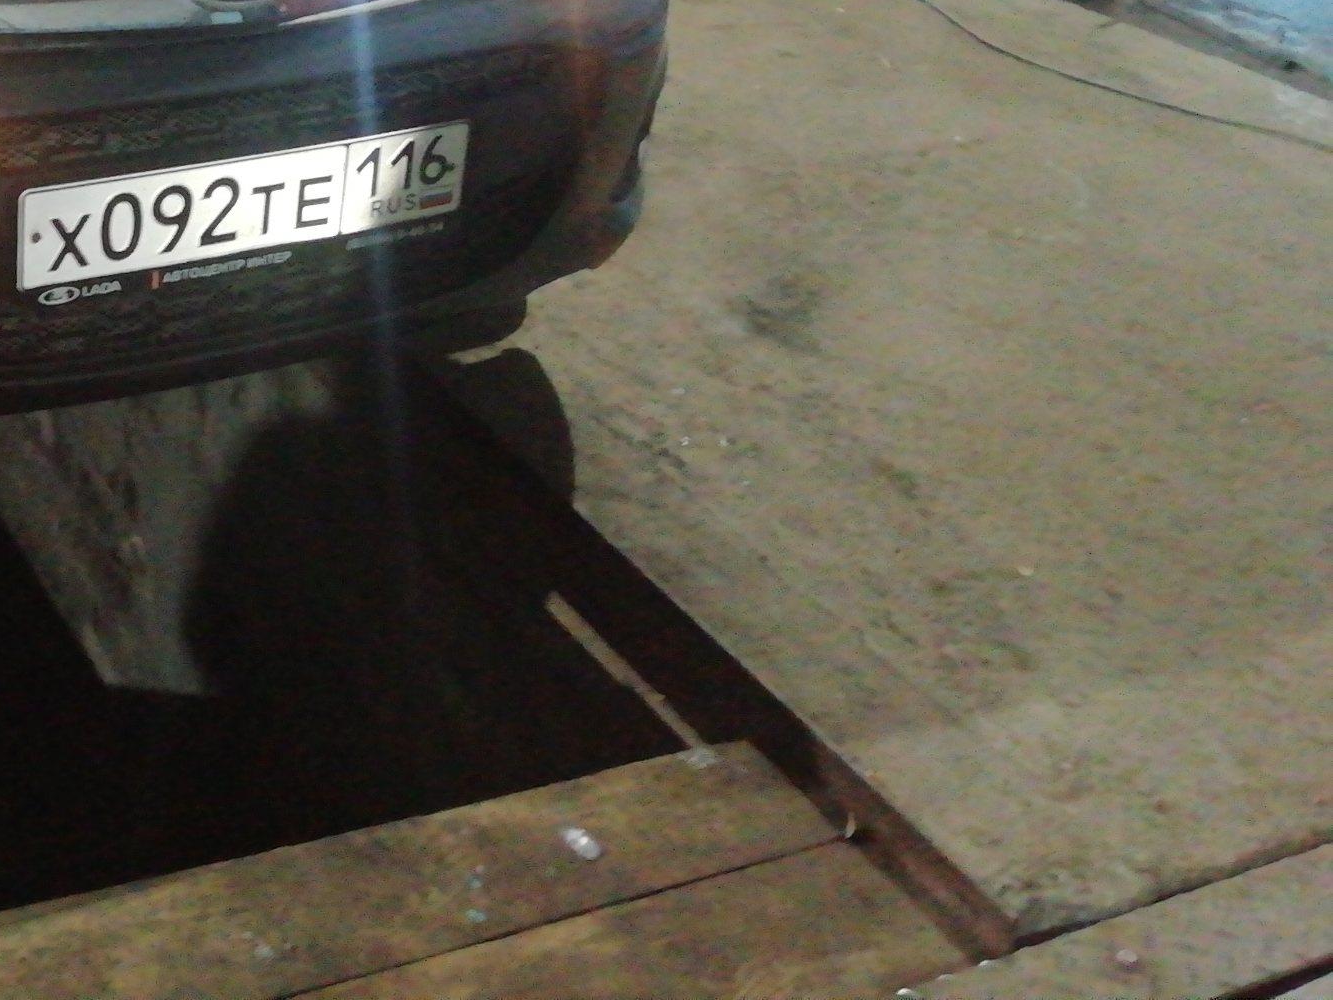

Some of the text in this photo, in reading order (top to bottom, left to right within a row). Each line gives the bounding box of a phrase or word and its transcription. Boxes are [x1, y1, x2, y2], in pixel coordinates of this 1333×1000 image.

[356, 134, 443, 198] 116
[371, 193, 416, 216] RUS
[81, 280, 122, 297] LADA
